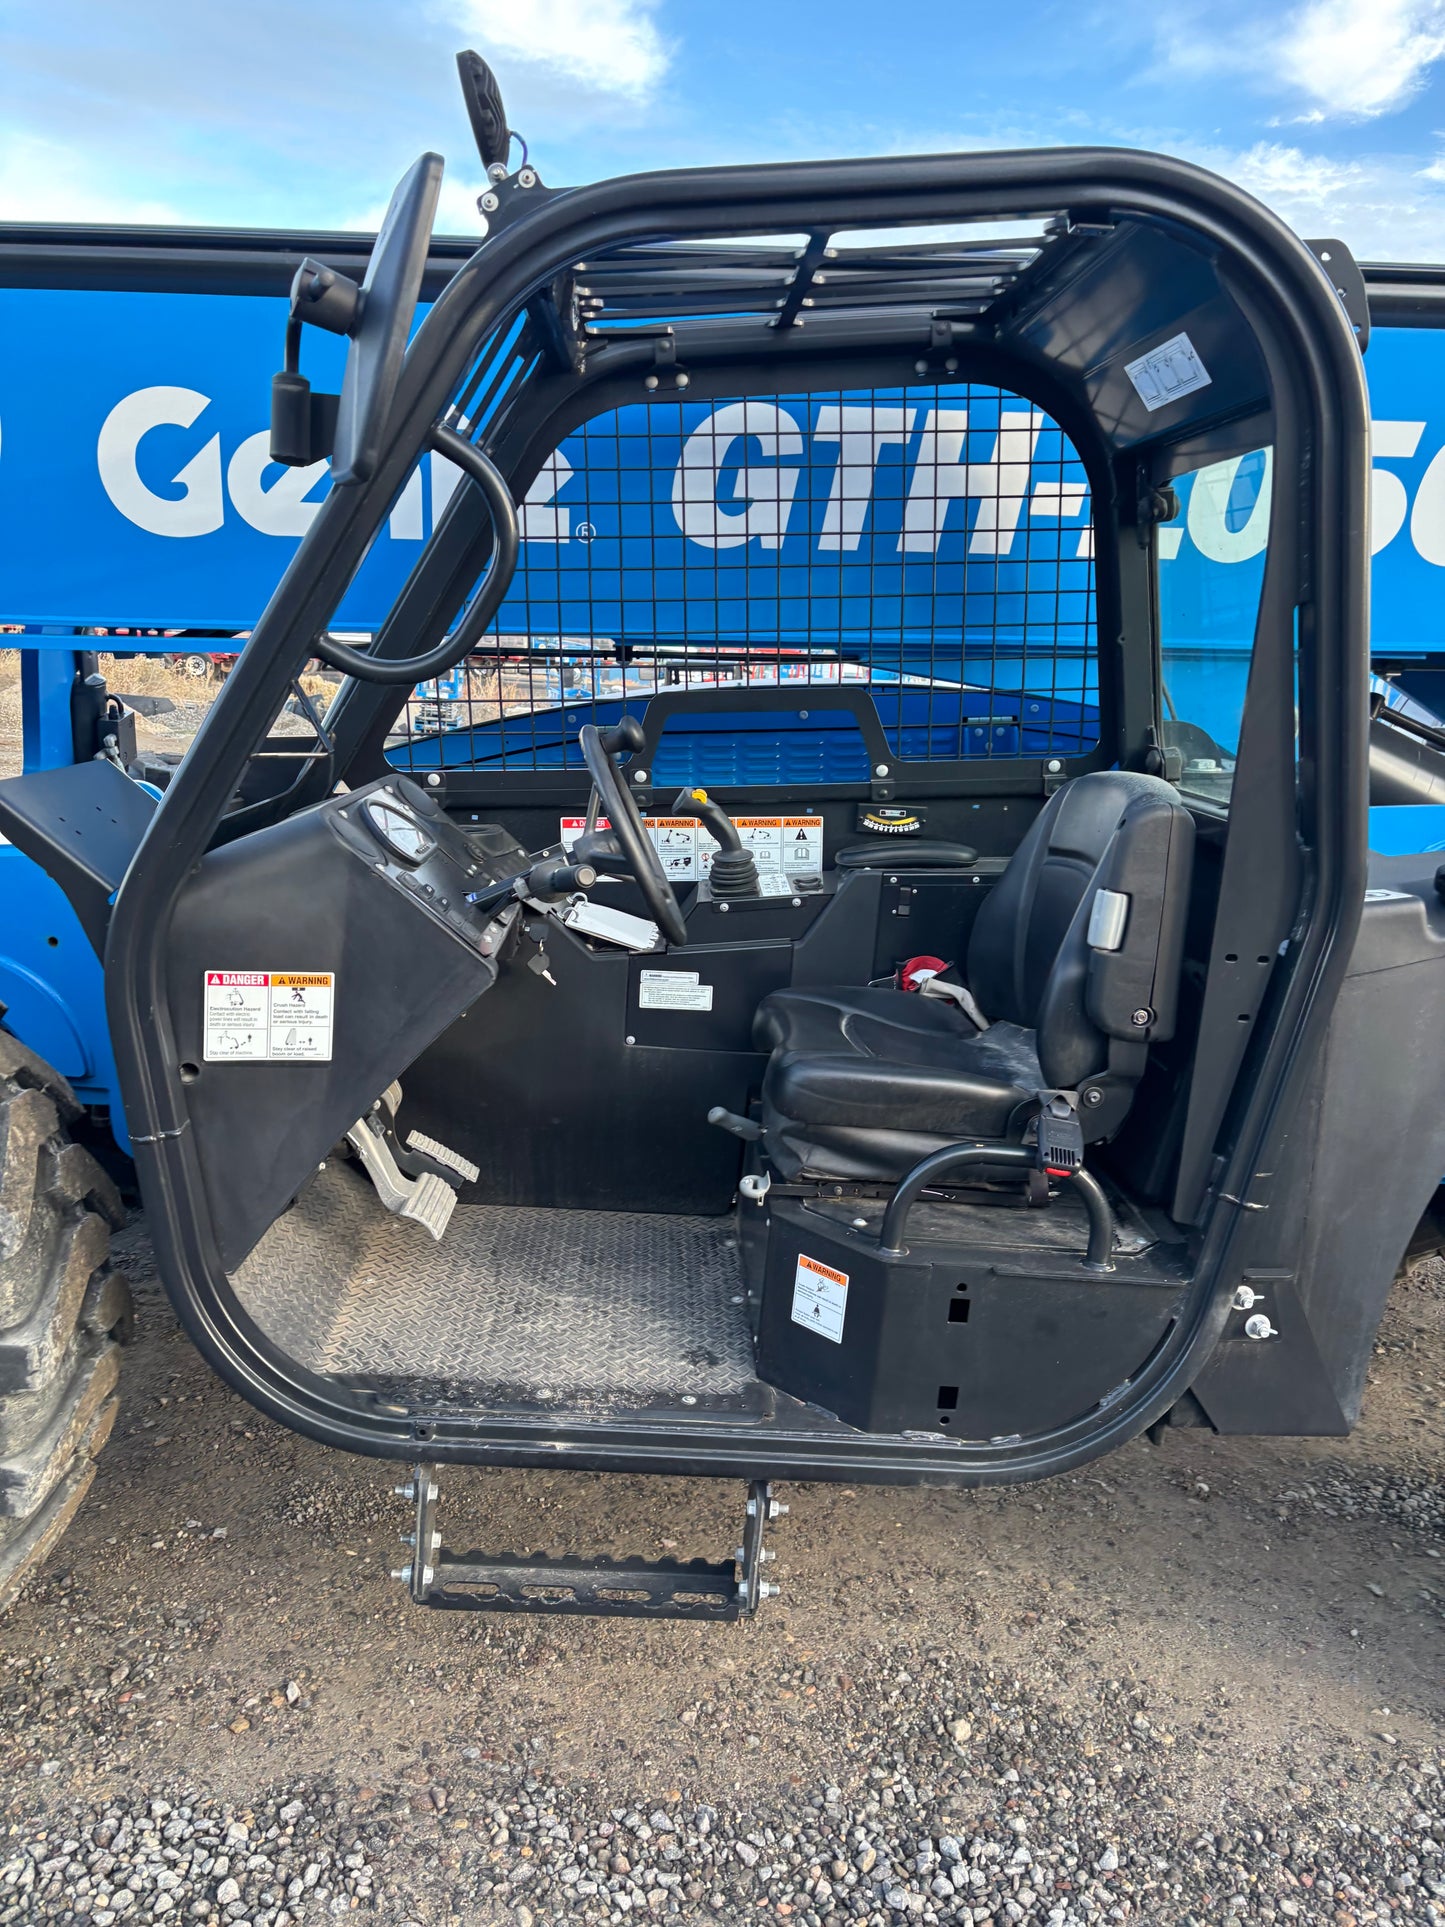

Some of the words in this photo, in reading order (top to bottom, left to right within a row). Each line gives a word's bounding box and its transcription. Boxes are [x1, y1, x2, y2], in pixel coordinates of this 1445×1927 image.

[97, 385, 574, 544] Gee
[671, 401, 1445, 567] GTH-05
[222, 975, 265, 985] DANGER
[288, 976, 328, 985] WARNING
[813, 1264, 841, 1282] WARNING
